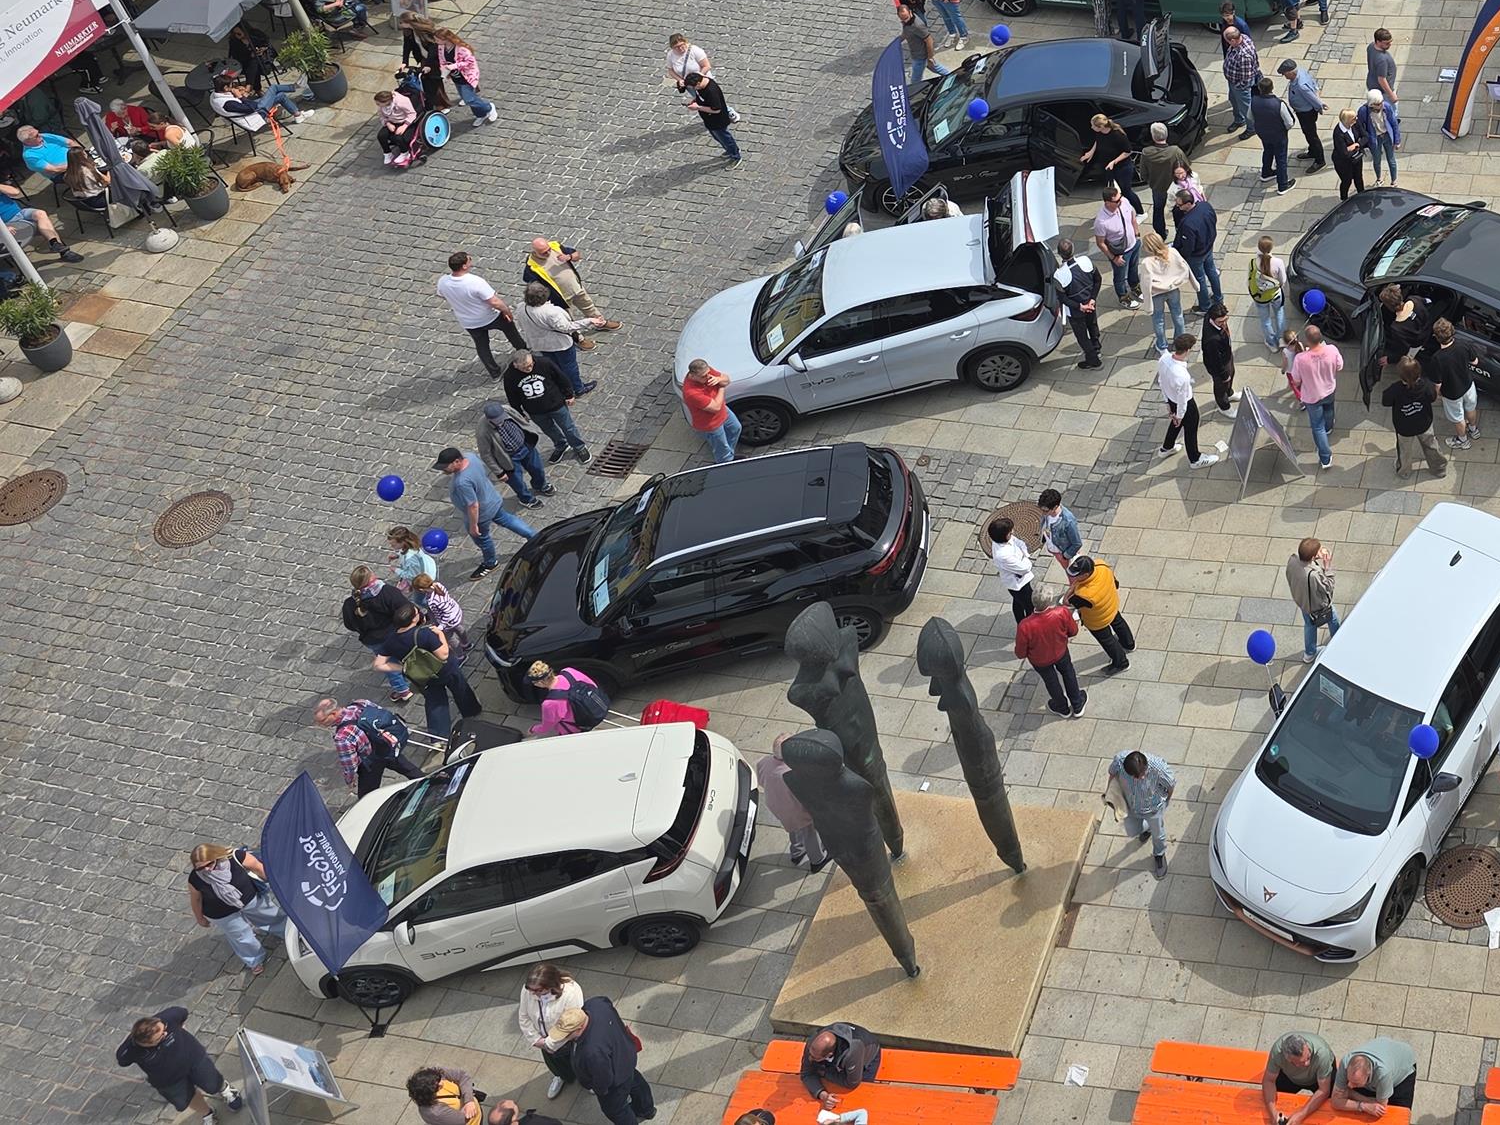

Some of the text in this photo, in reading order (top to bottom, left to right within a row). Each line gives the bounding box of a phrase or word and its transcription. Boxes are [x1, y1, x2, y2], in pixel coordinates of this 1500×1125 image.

[5, 27, 44, 58] Innovation
[521, 380, 545, 397] 99
[298, 835, 345, 898] Fischer
[315, 831, 346, 876] AUTOMOBILE
[420, 947, 466, 961] BYD
